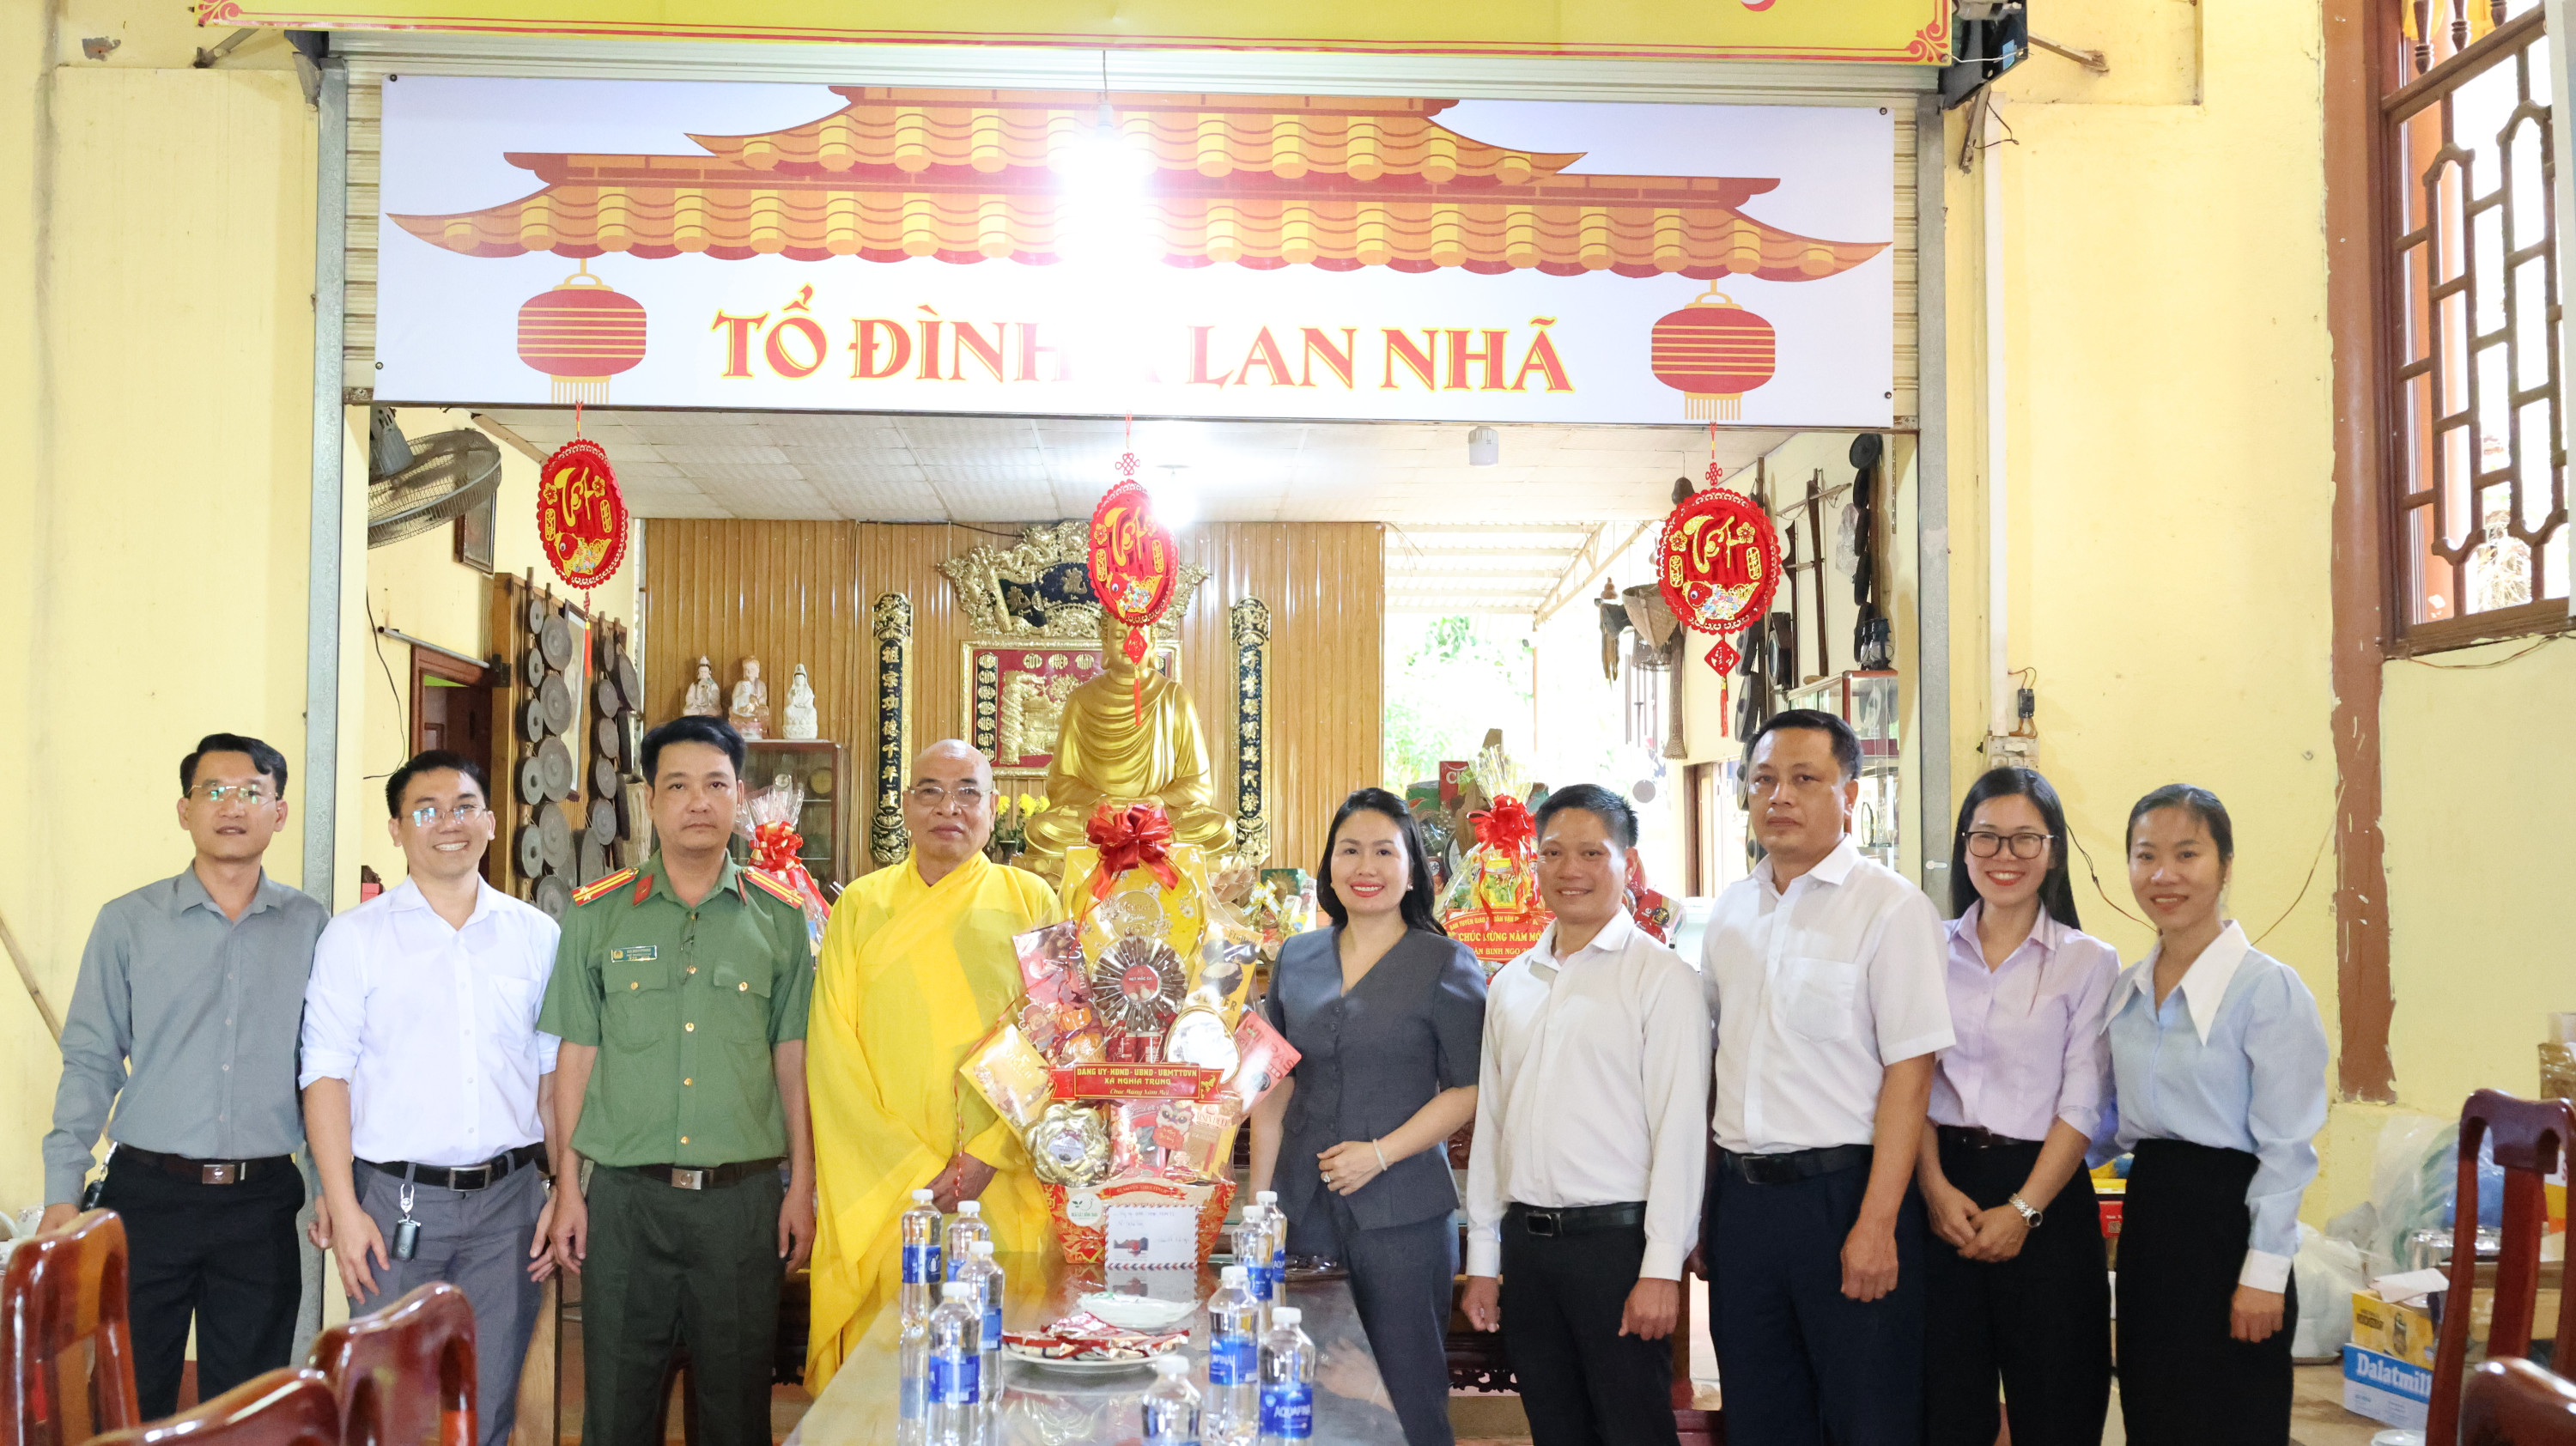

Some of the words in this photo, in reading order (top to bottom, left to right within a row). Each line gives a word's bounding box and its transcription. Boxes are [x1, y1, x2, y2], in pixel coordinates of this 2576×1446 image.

[711, 283, 828, 380] TỔ
[847, 303, 1072, 382] ĐÌNH
[1184, 325, 1357, 391] LAN
[1379, 314, 1576, 392] NHÃ
[1458, 930, 1481, 942] CHÚC
[1509, 930, 1528, 942] NĂM
[1529, 929, 1542, 942] MỚ
